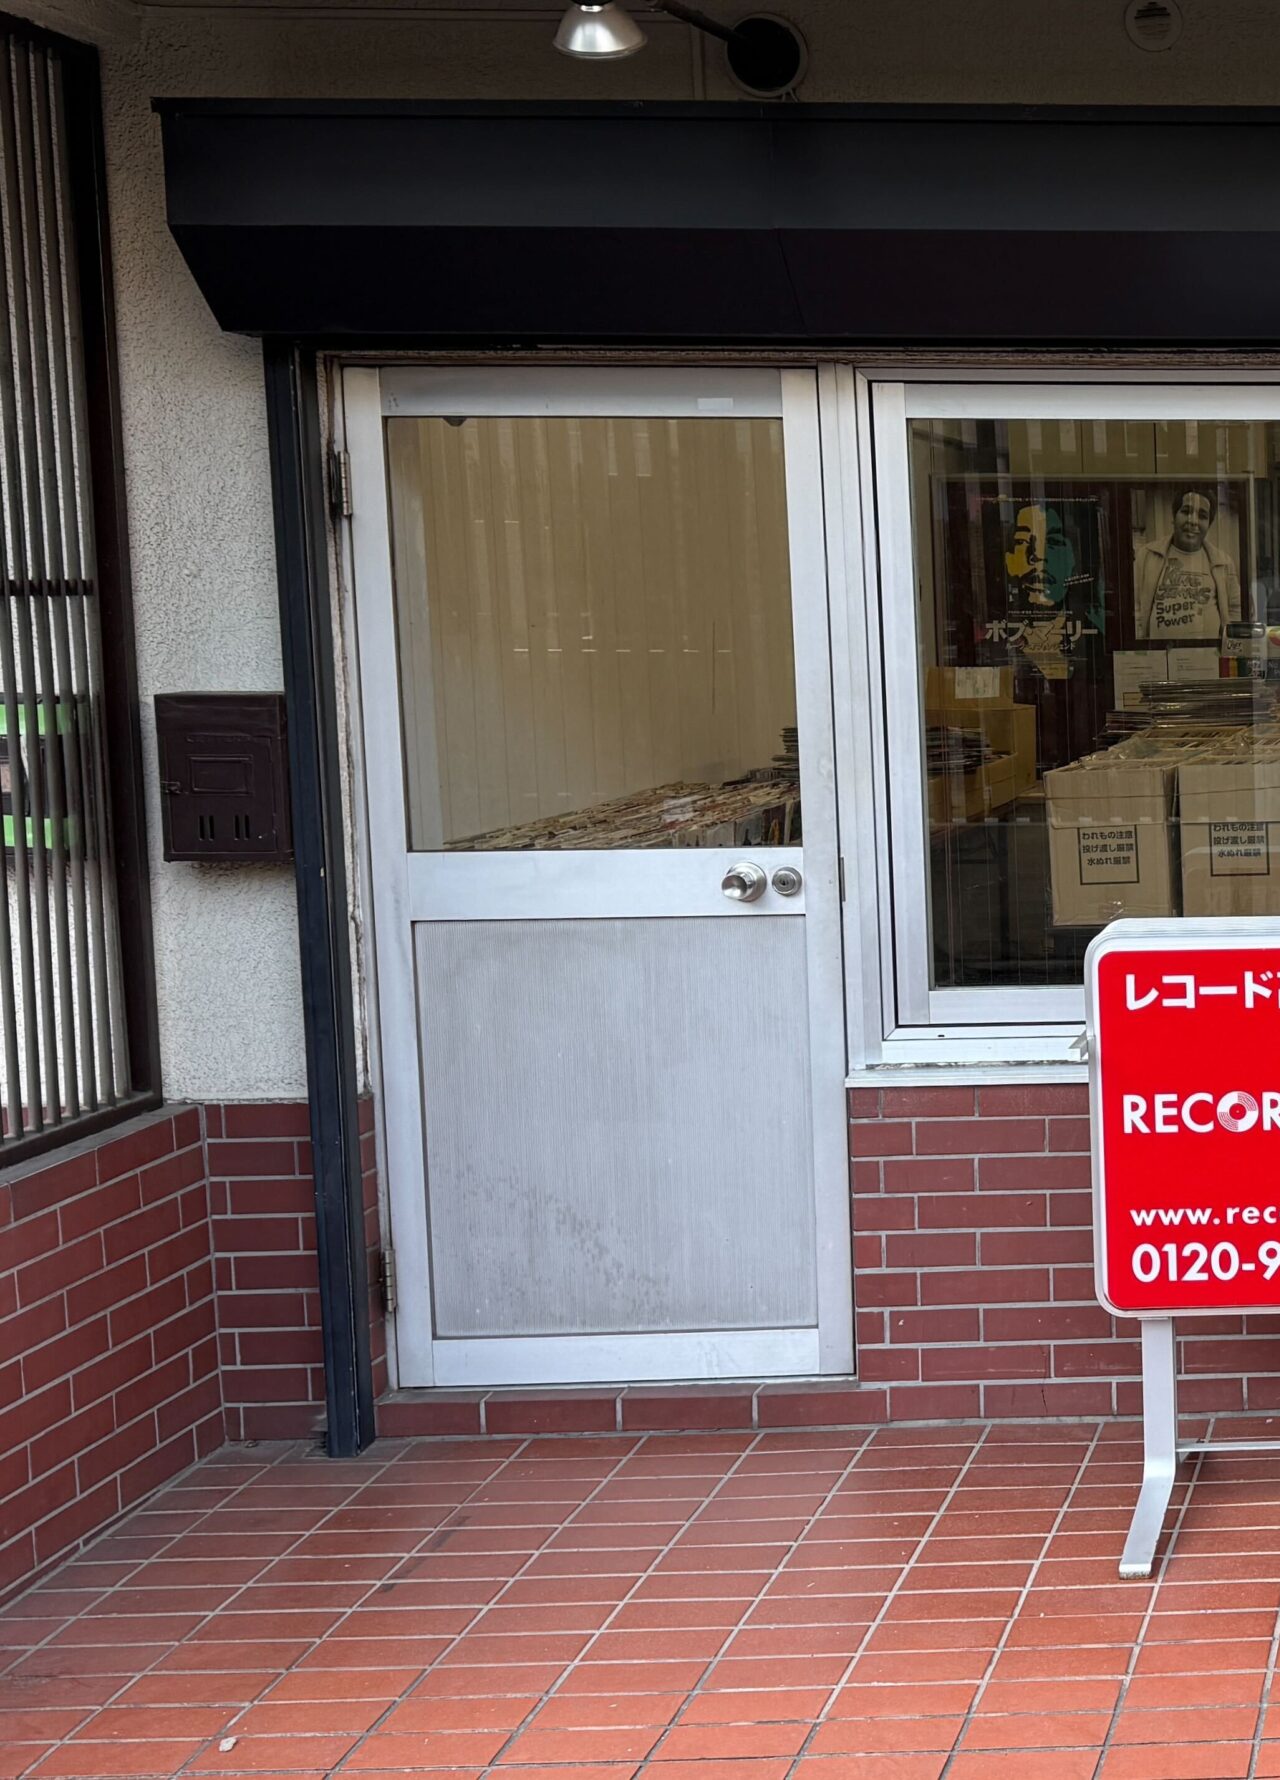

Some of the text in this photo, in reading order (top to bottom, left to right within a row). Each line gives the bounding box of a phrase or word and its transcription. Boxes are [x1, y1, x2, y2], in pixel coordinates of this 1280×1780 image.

[1156, 601, 1196, 615] Super
[1156, 614, 1195, 628] Power
[985, 619, 1099, 642] ボブ・マーリー
